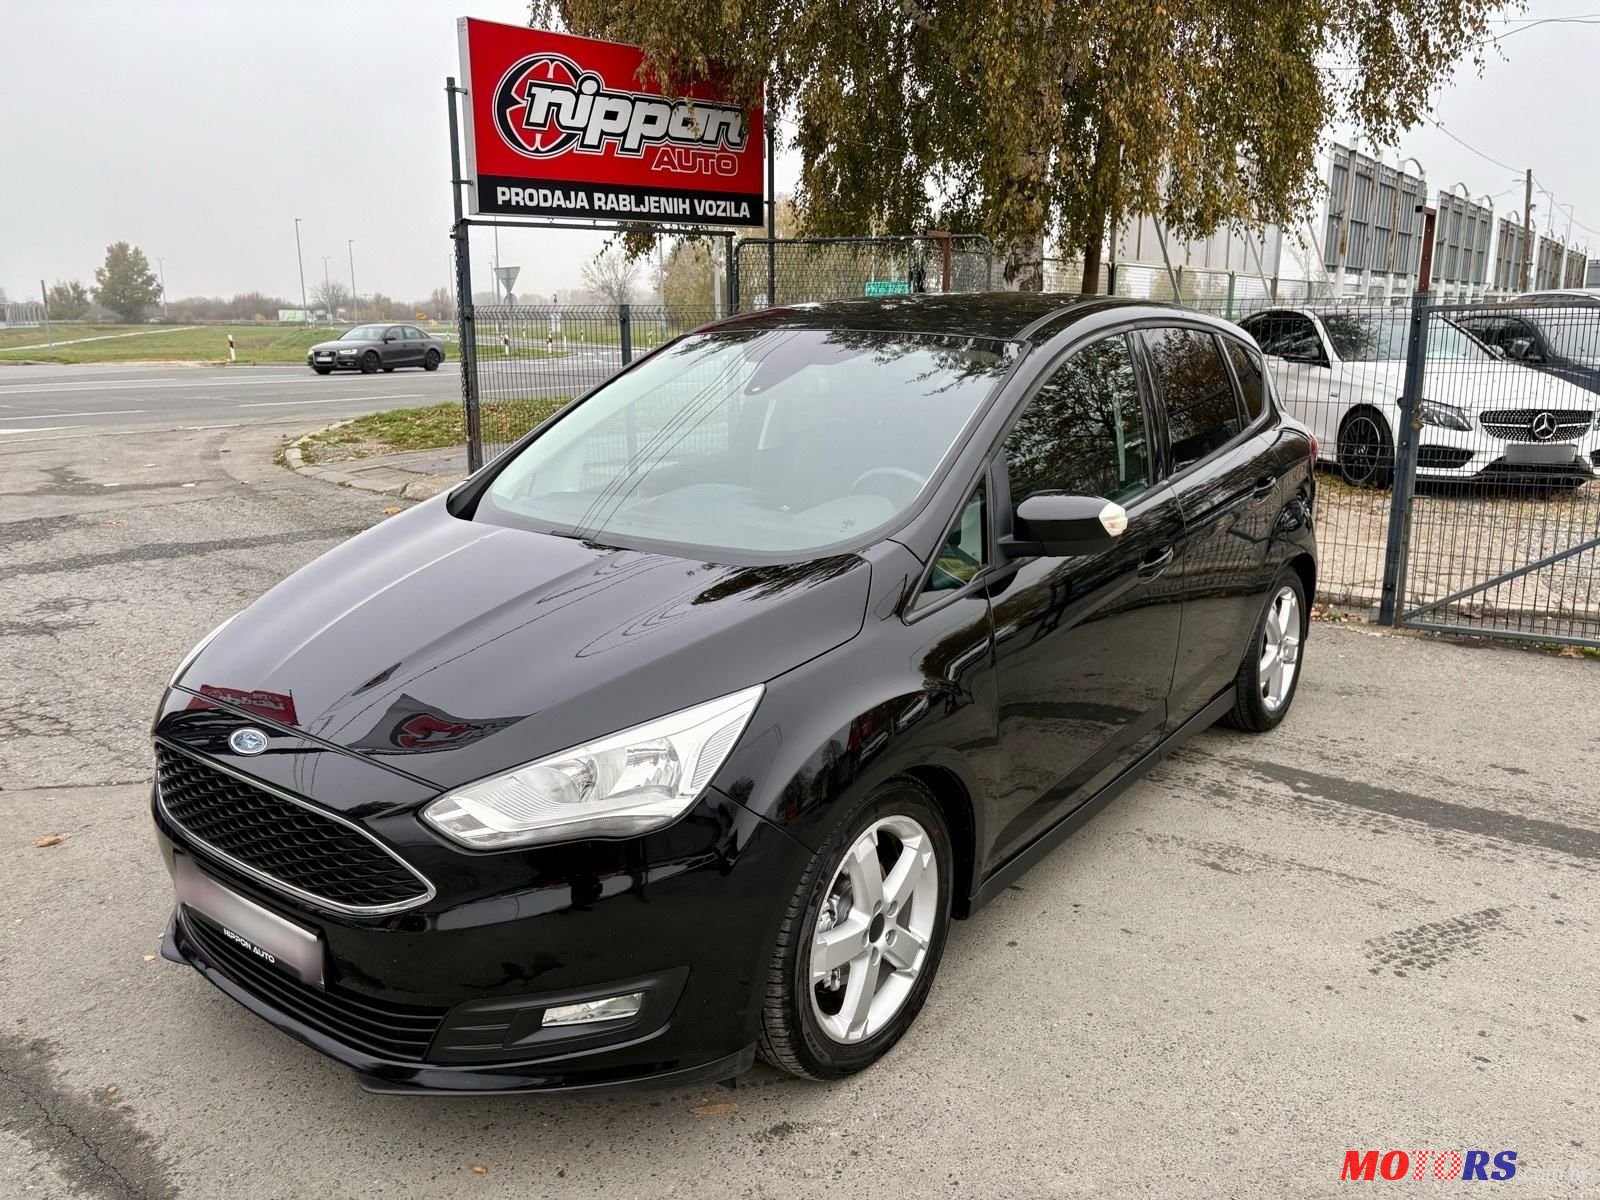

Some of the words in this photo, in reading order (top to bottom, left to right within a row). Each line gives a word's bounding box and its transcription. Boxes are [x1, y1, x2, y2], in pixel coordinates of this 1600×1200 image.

[527, 78, 743, 150] nippon
[651, 147, 739, 177] AUTO
[496, 186, 590, 210] PRODAJA
[593, 192, 690, 215] RABLJENIH
[693, 199, 751, 218] VOZILA
[223, 927, 252, 951] NIPPON
[252, 946, 276, 964] AUTO
